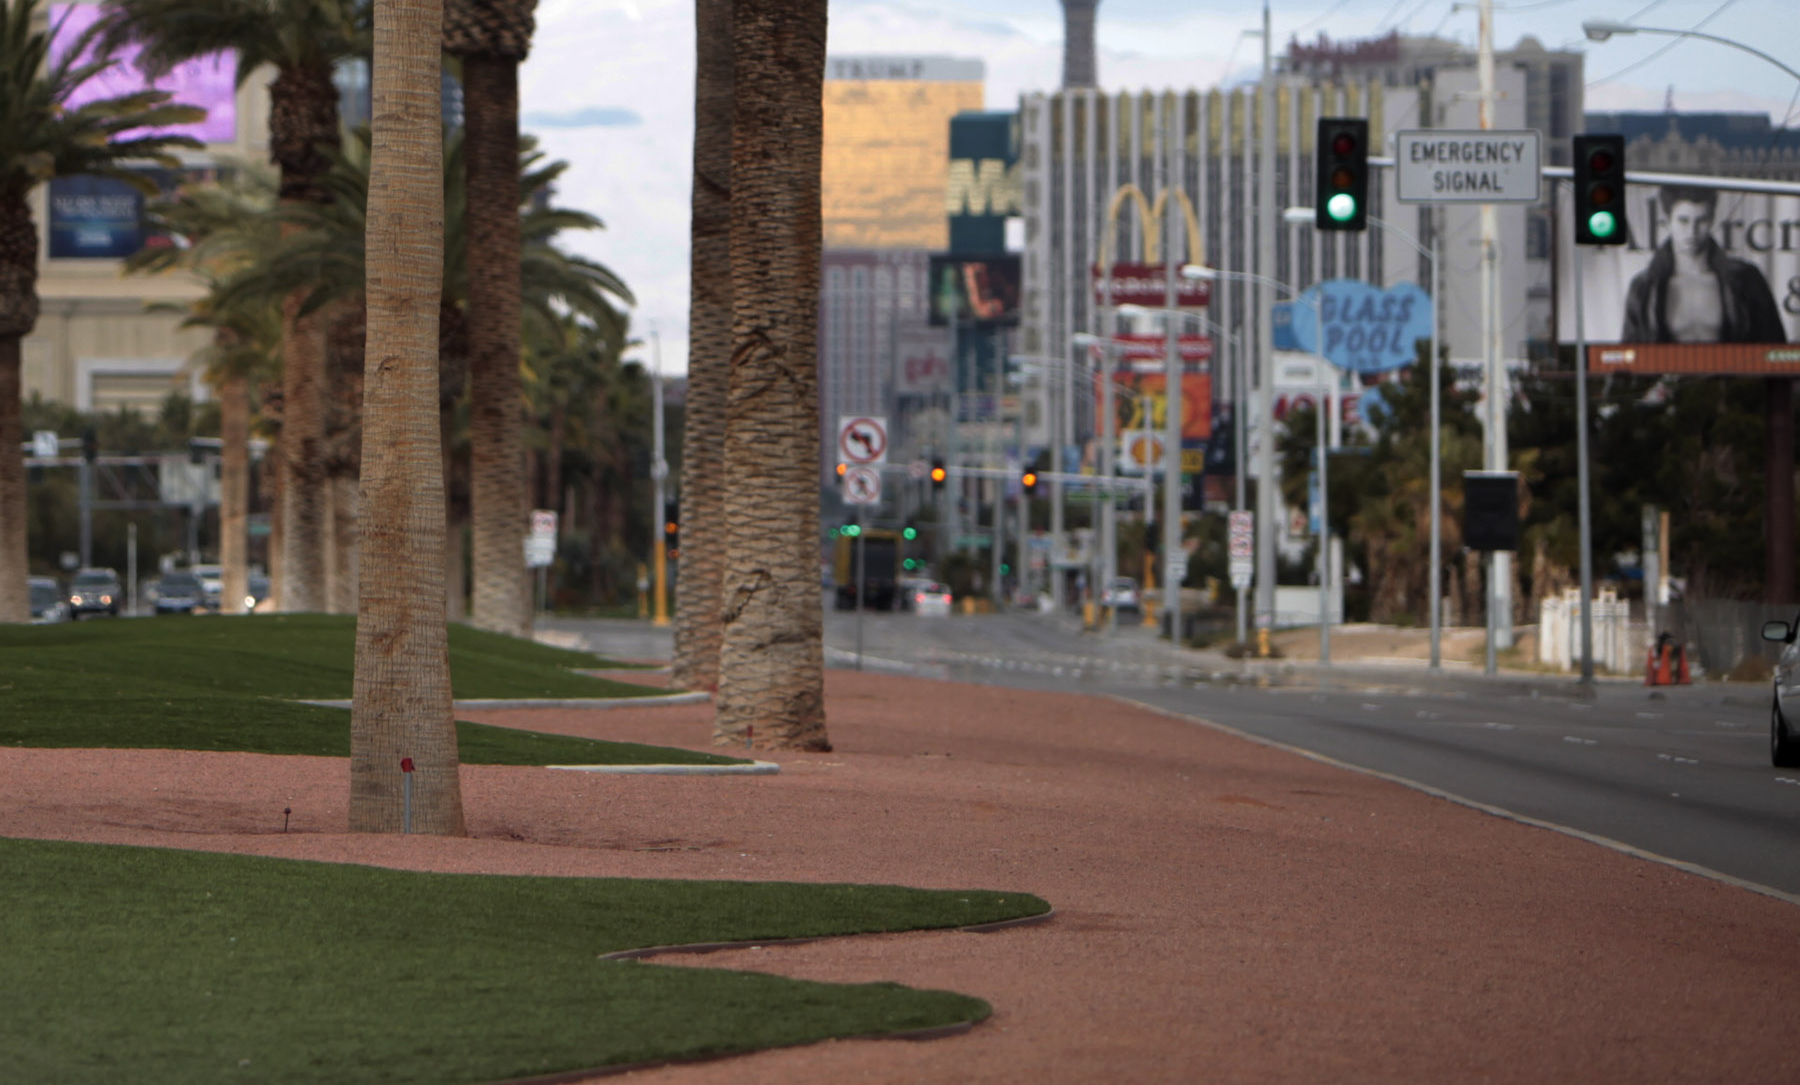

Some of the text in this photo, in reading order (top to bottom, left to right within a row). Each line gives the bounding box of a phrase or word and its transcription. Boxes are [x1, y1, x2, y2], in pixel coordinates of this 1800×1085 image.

[1410, 141, 1525, 164] EMERGENCY
[1433, 170, 1503, 194] SIGNAL
[1321, 294, 1416, 324] GLASS
[1326, 322, 1406, 354] POOL
